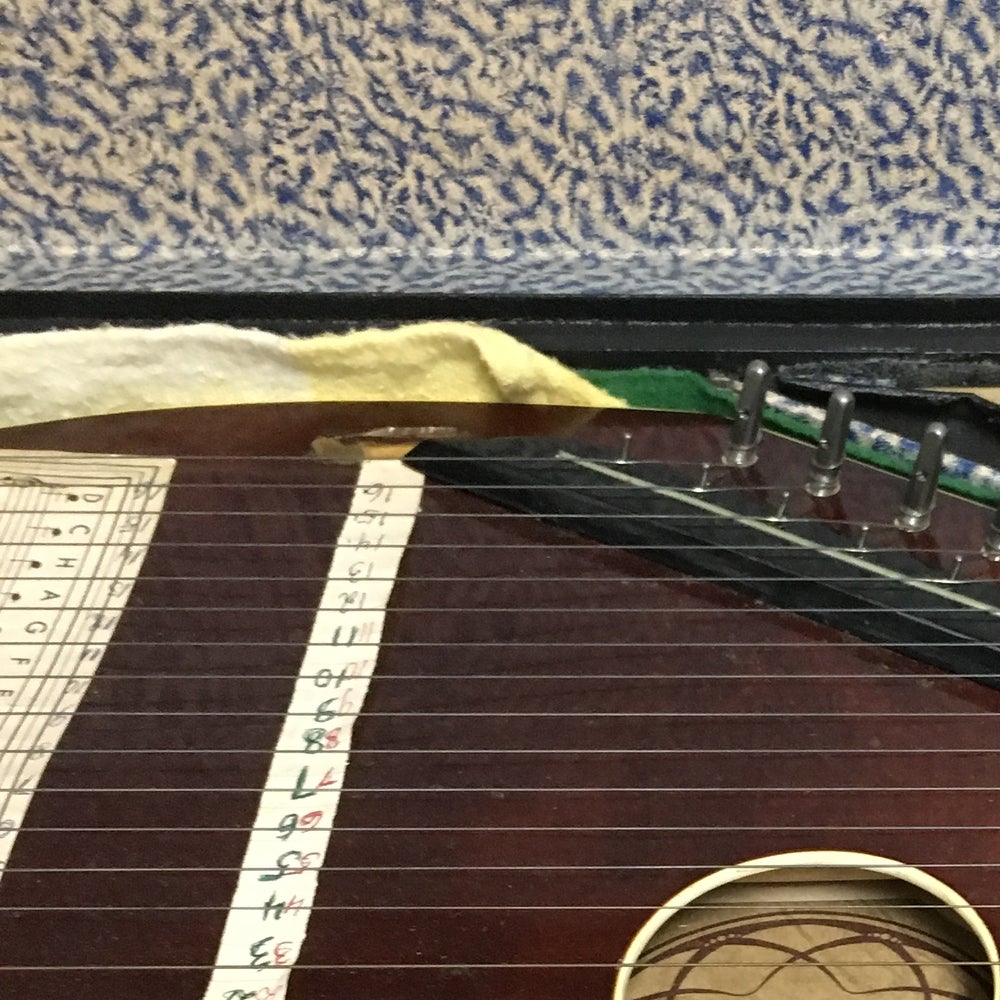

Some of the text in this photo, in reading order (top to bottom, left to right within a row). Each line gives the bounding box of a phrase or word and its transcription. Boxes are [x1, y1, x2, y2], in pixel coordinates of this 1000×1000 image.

[83, 492, 104, 503] D
[69, 524, 92, 536] C
[55, 557, 77, 569] H
[40, 590, 62, 601] A
[24, 620, 48, 634] G
[10, 657, 30, 666] F
